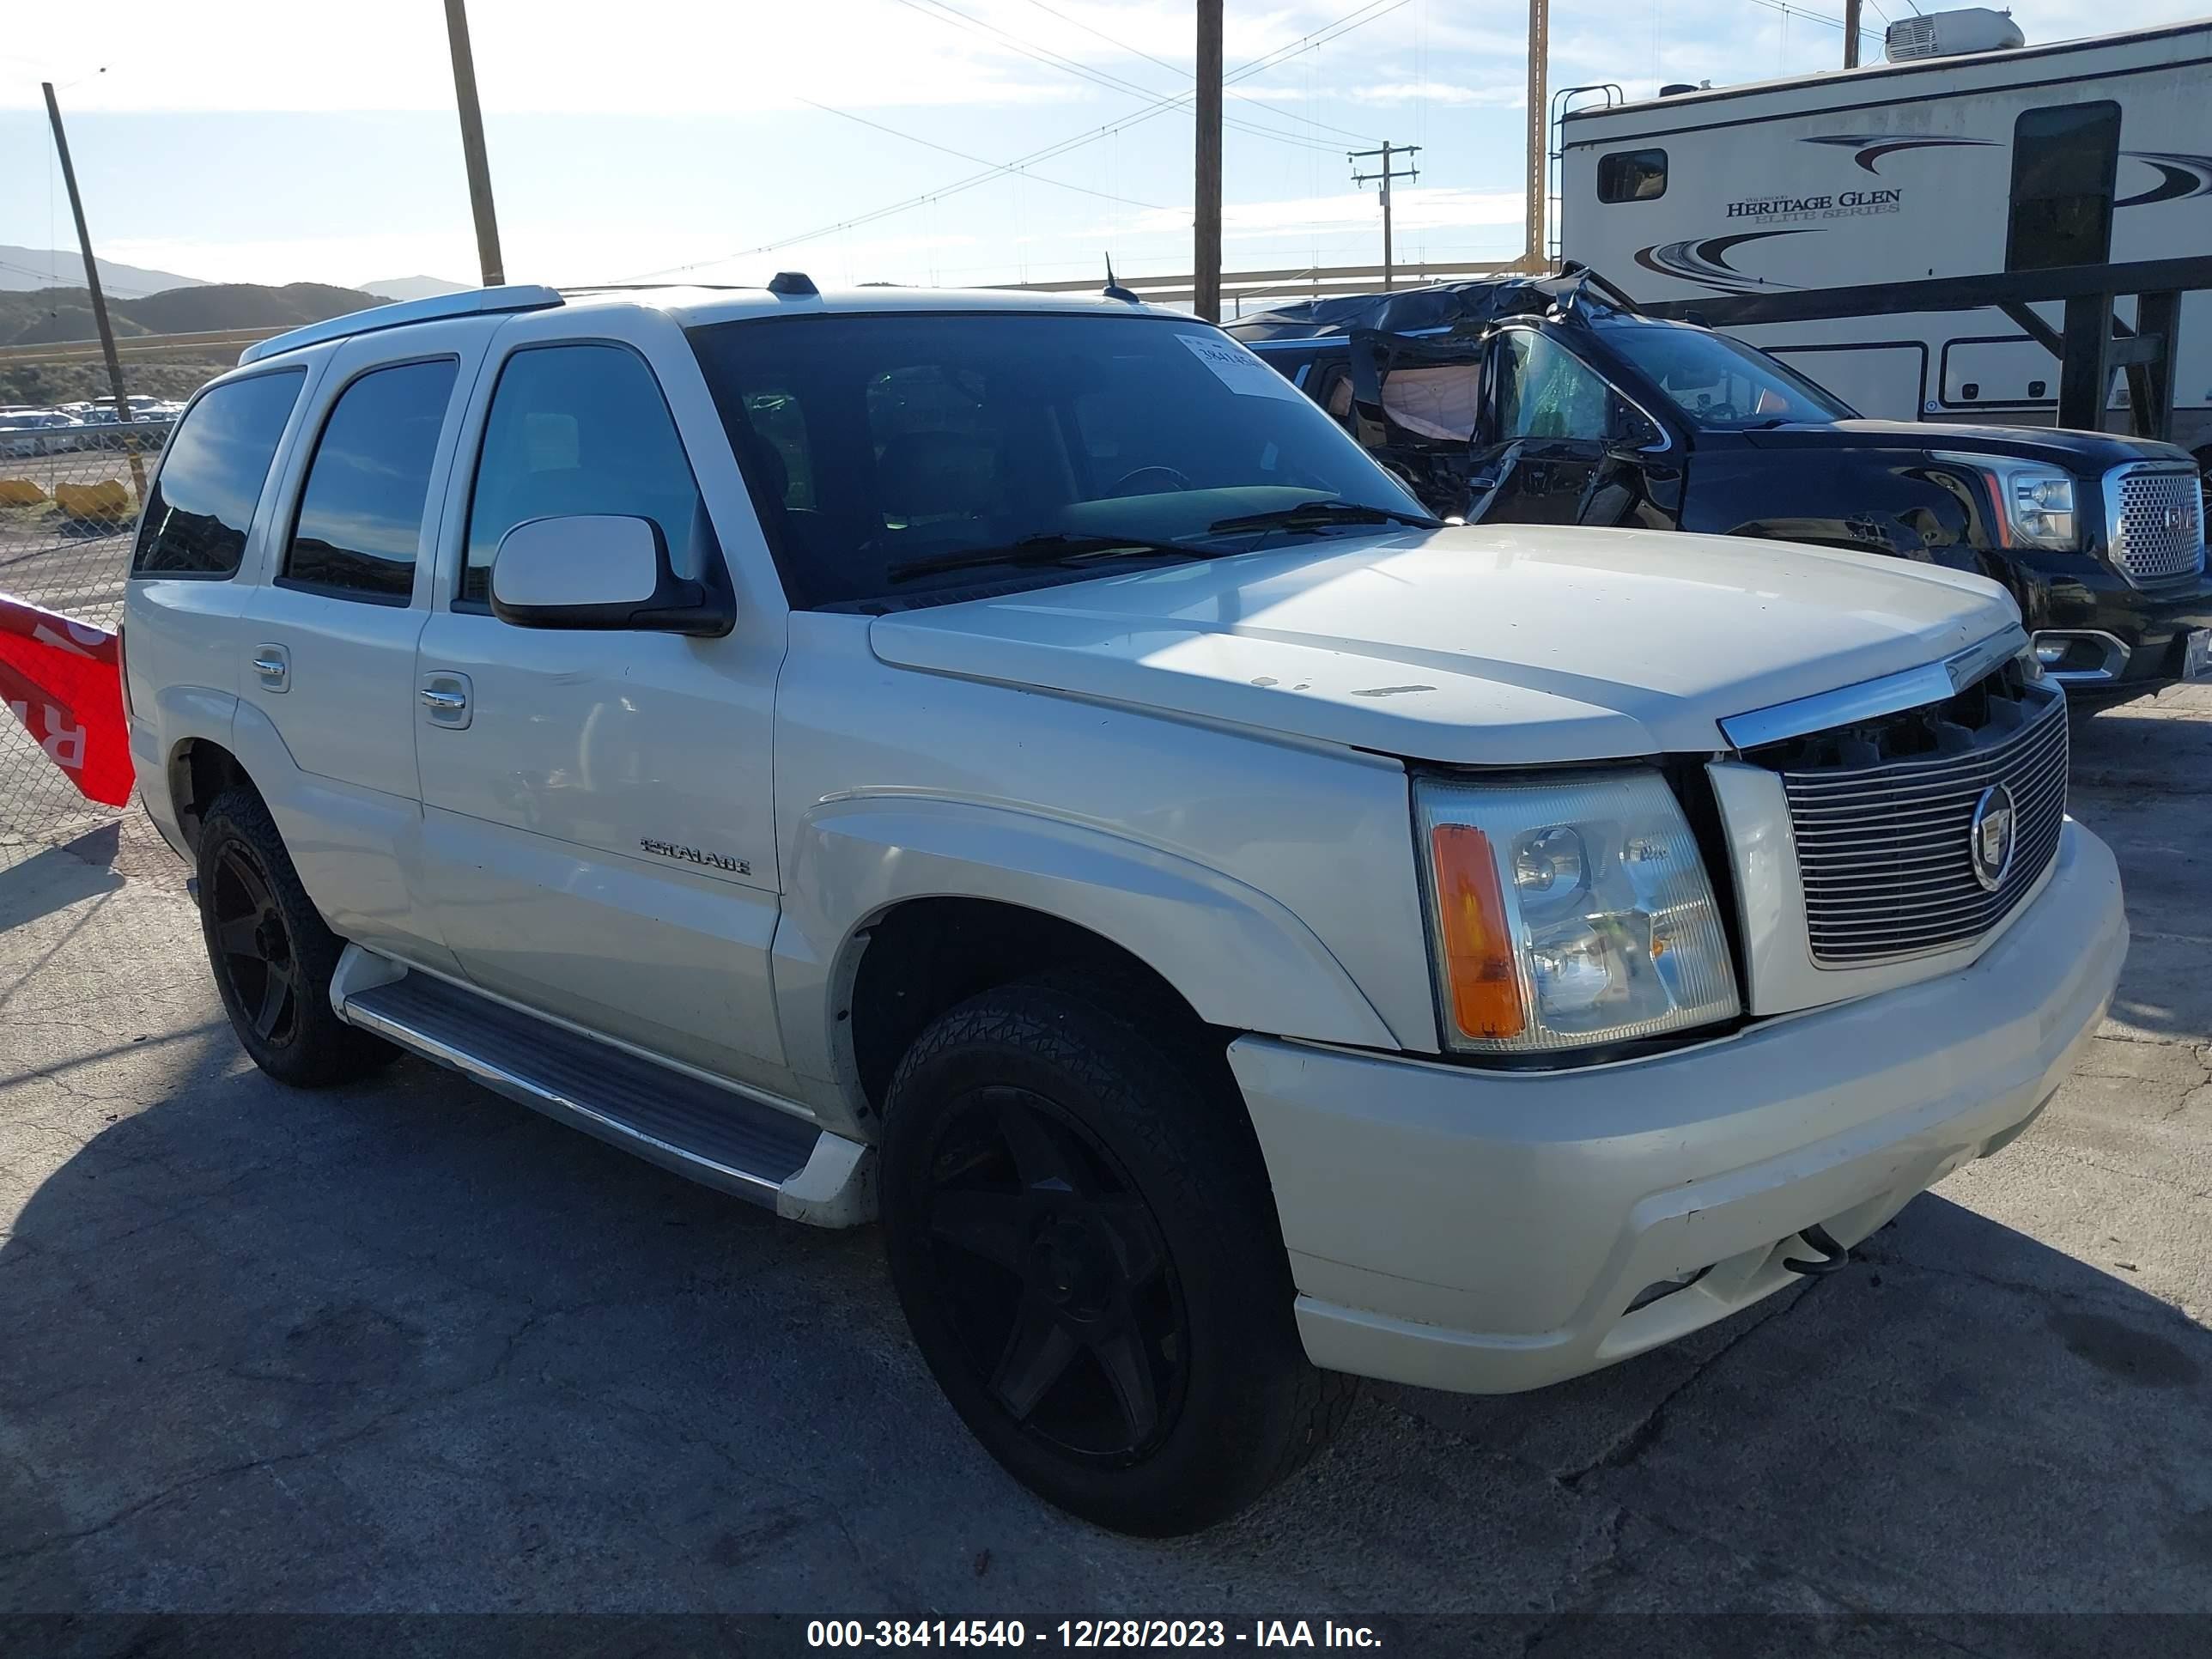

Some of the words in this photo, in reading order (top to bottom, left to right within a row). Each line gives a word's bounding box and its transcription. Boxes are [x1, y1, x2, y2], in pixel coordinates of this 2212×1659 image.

[1726, 197, 1832, 218] HERITAGE
[1838, 189, 1902, 207] GLEN
[1754, 210, 1816, 225] ELITE
[1822, 204, 1900, 220] SERIES
